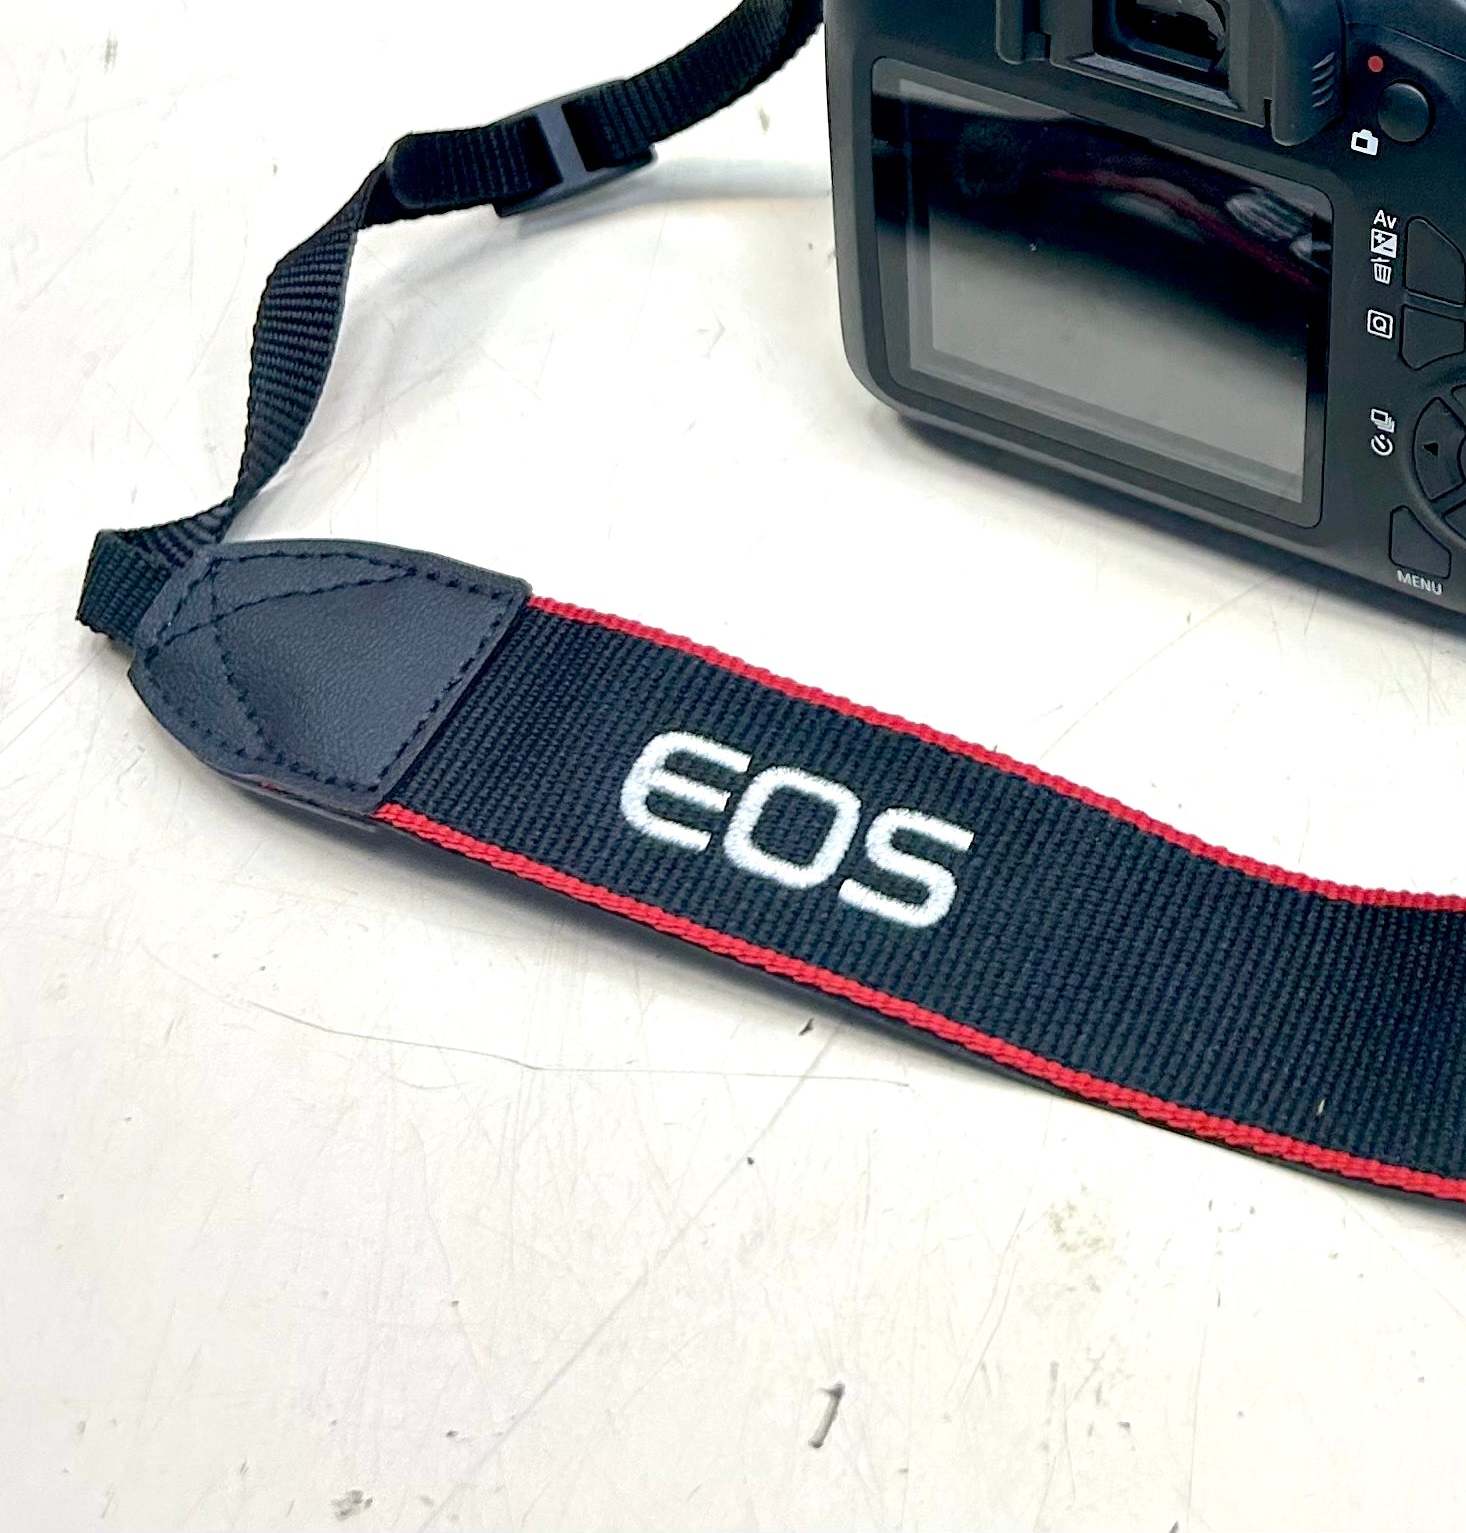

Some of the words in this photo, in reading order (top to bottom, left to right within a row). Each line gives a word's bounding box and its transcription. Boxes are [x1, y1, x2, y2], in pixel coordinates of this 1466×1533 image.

[1373, 210, 1397, 229] Av
[1396, 570, 1443, 596] MENU
[620, 730, 975, 928] EOS
